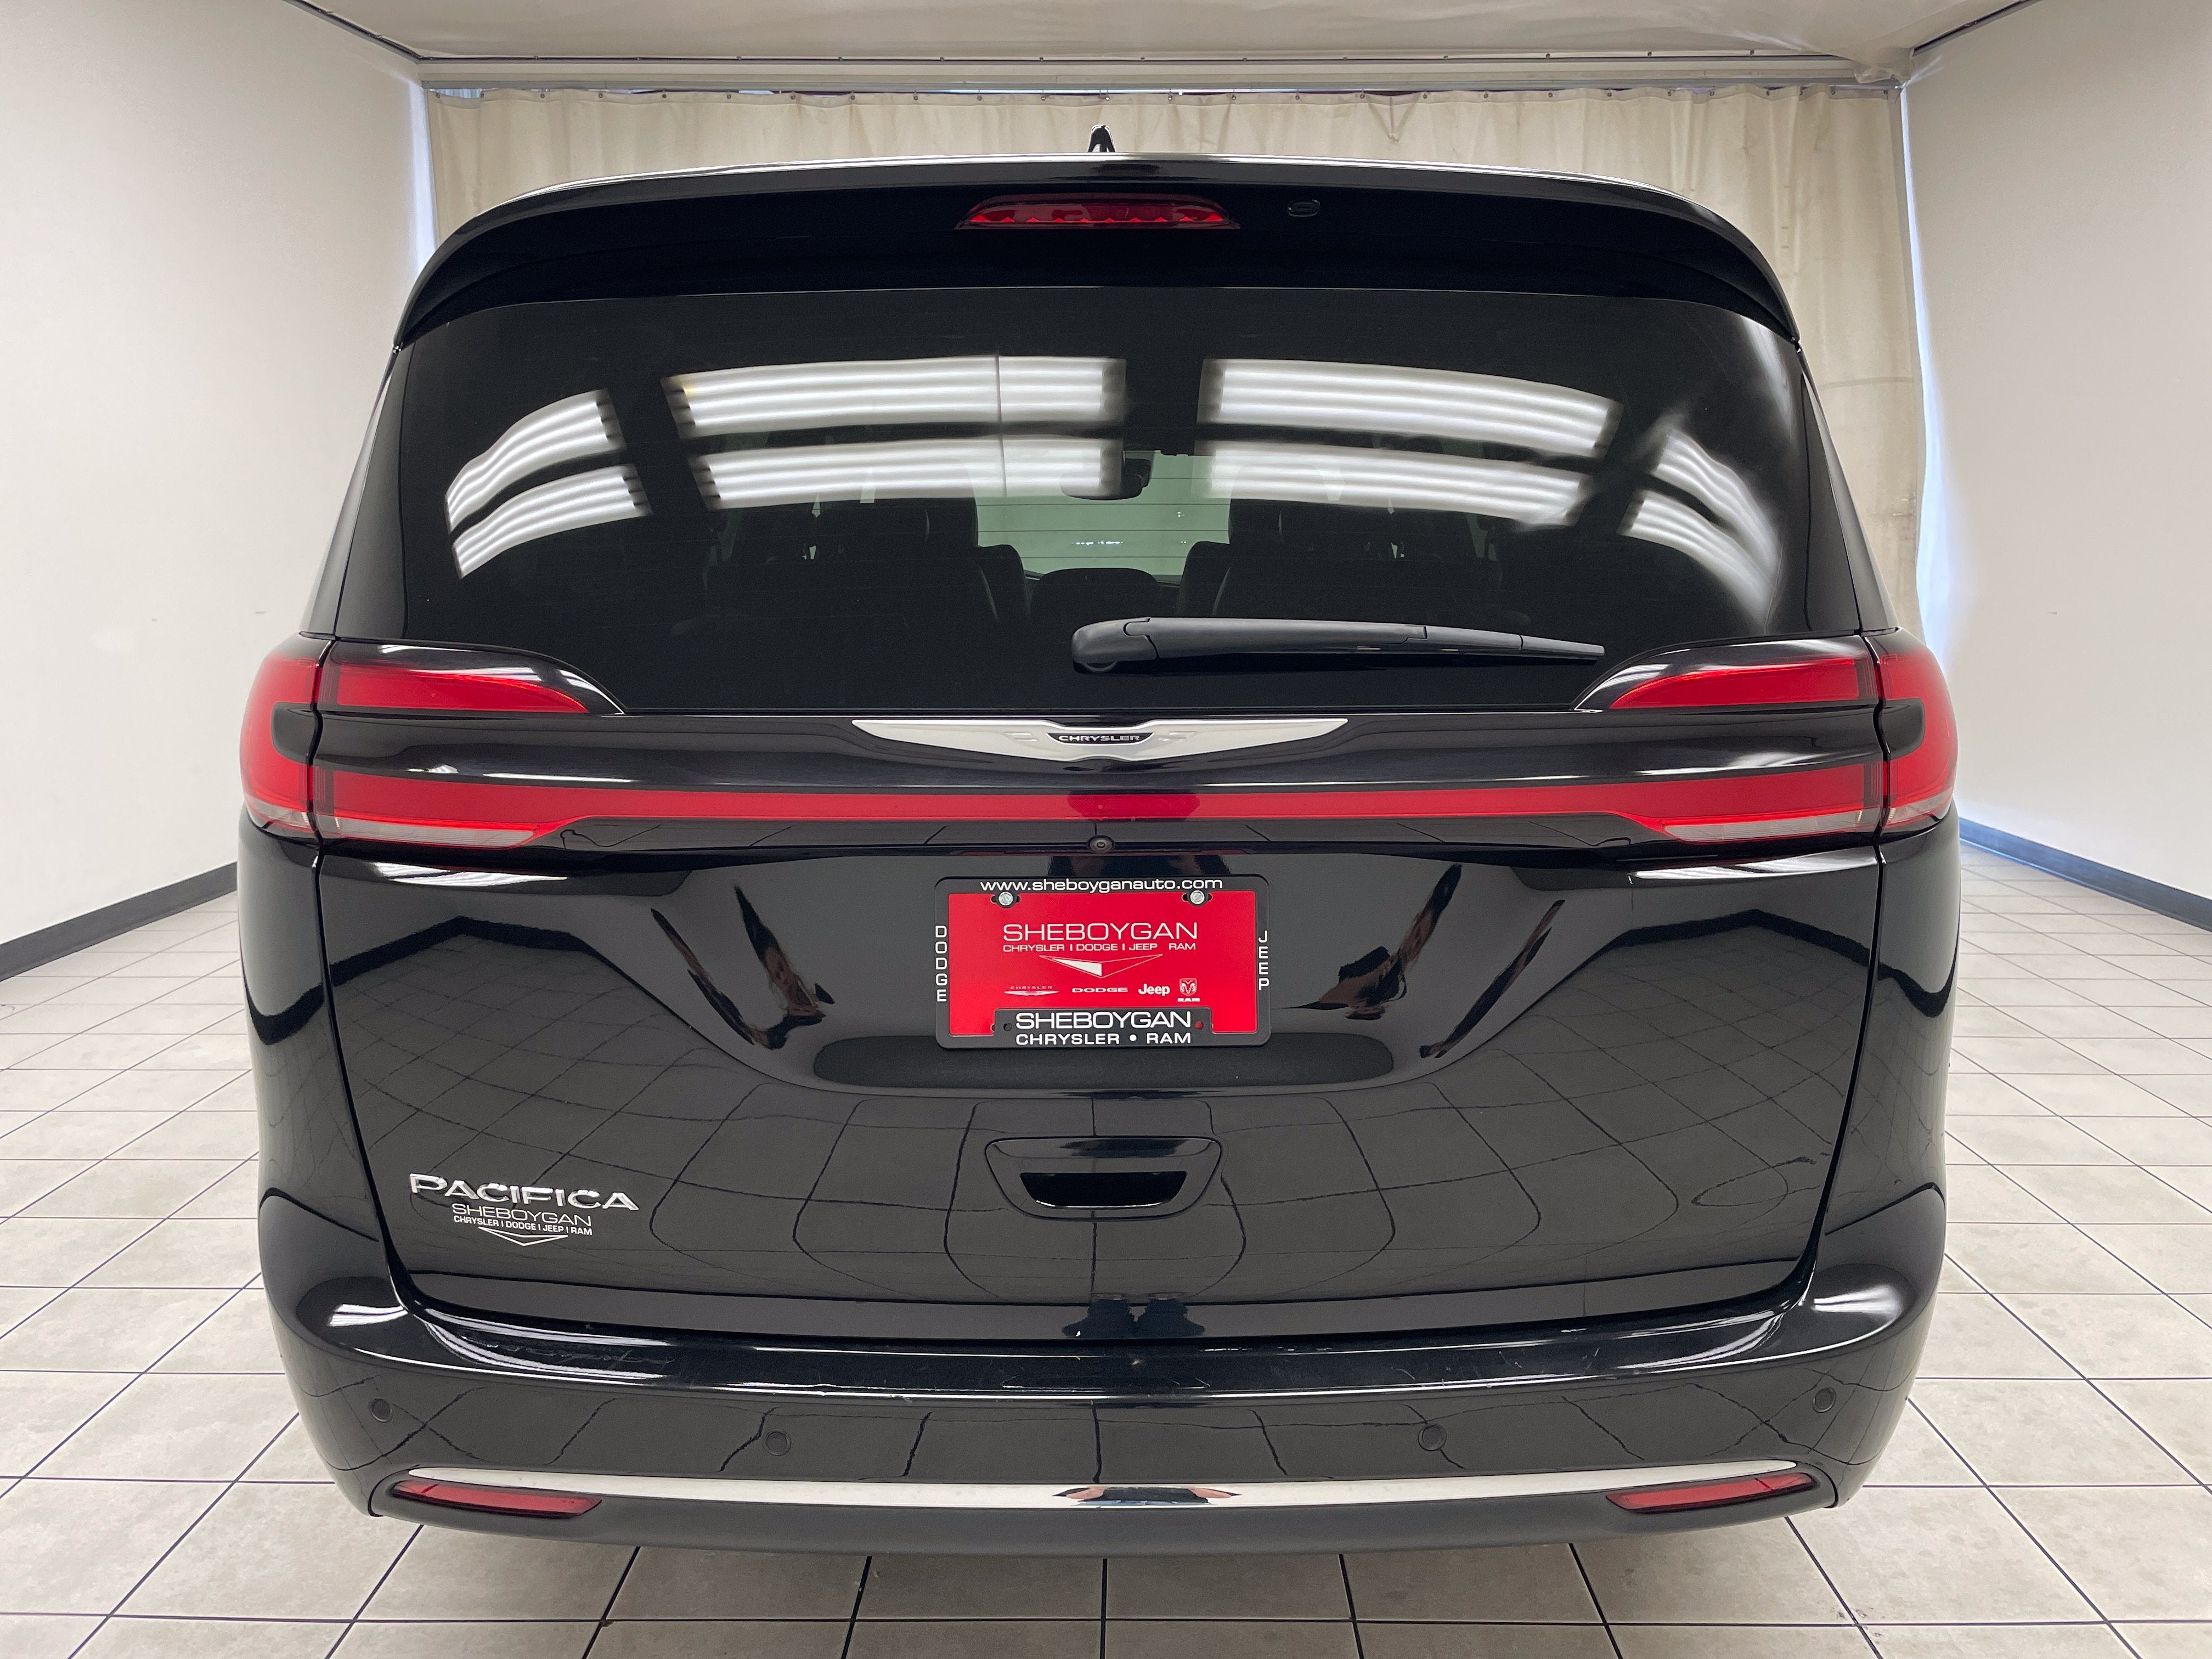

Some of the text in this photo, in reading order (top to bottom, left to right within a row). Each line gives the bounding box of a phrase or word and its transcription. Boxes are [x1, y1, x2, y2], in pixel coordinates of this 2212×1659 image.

[980, 878, 1223, 893] www.sheboyganauto.com
[1003, 922, 1198, 941] SHEBOYGAN
[1003, 944, 1065, 952] CHRYSLER
[1076, 943, 1118, 951] DODGE
[1128, 943, 1158, 951] JEEP
[935, 925, 948, 1002] DODGE
[1257, 930, 1269, 991] JEEP
[1138, 983, 1170, 996] Jeep
[1015, 1011, 1191, 1030] SHEBOYGAN
[1015, 1032, 1192, 1046] CHRYSLER RAM
[409, 1173, 640, 1211] PACIFICA
[452, 1203, 592, 1227] SHEBOYGAN
[453, 1215, 593, 1236] CHRYSLER DODGE JEEP RAM
